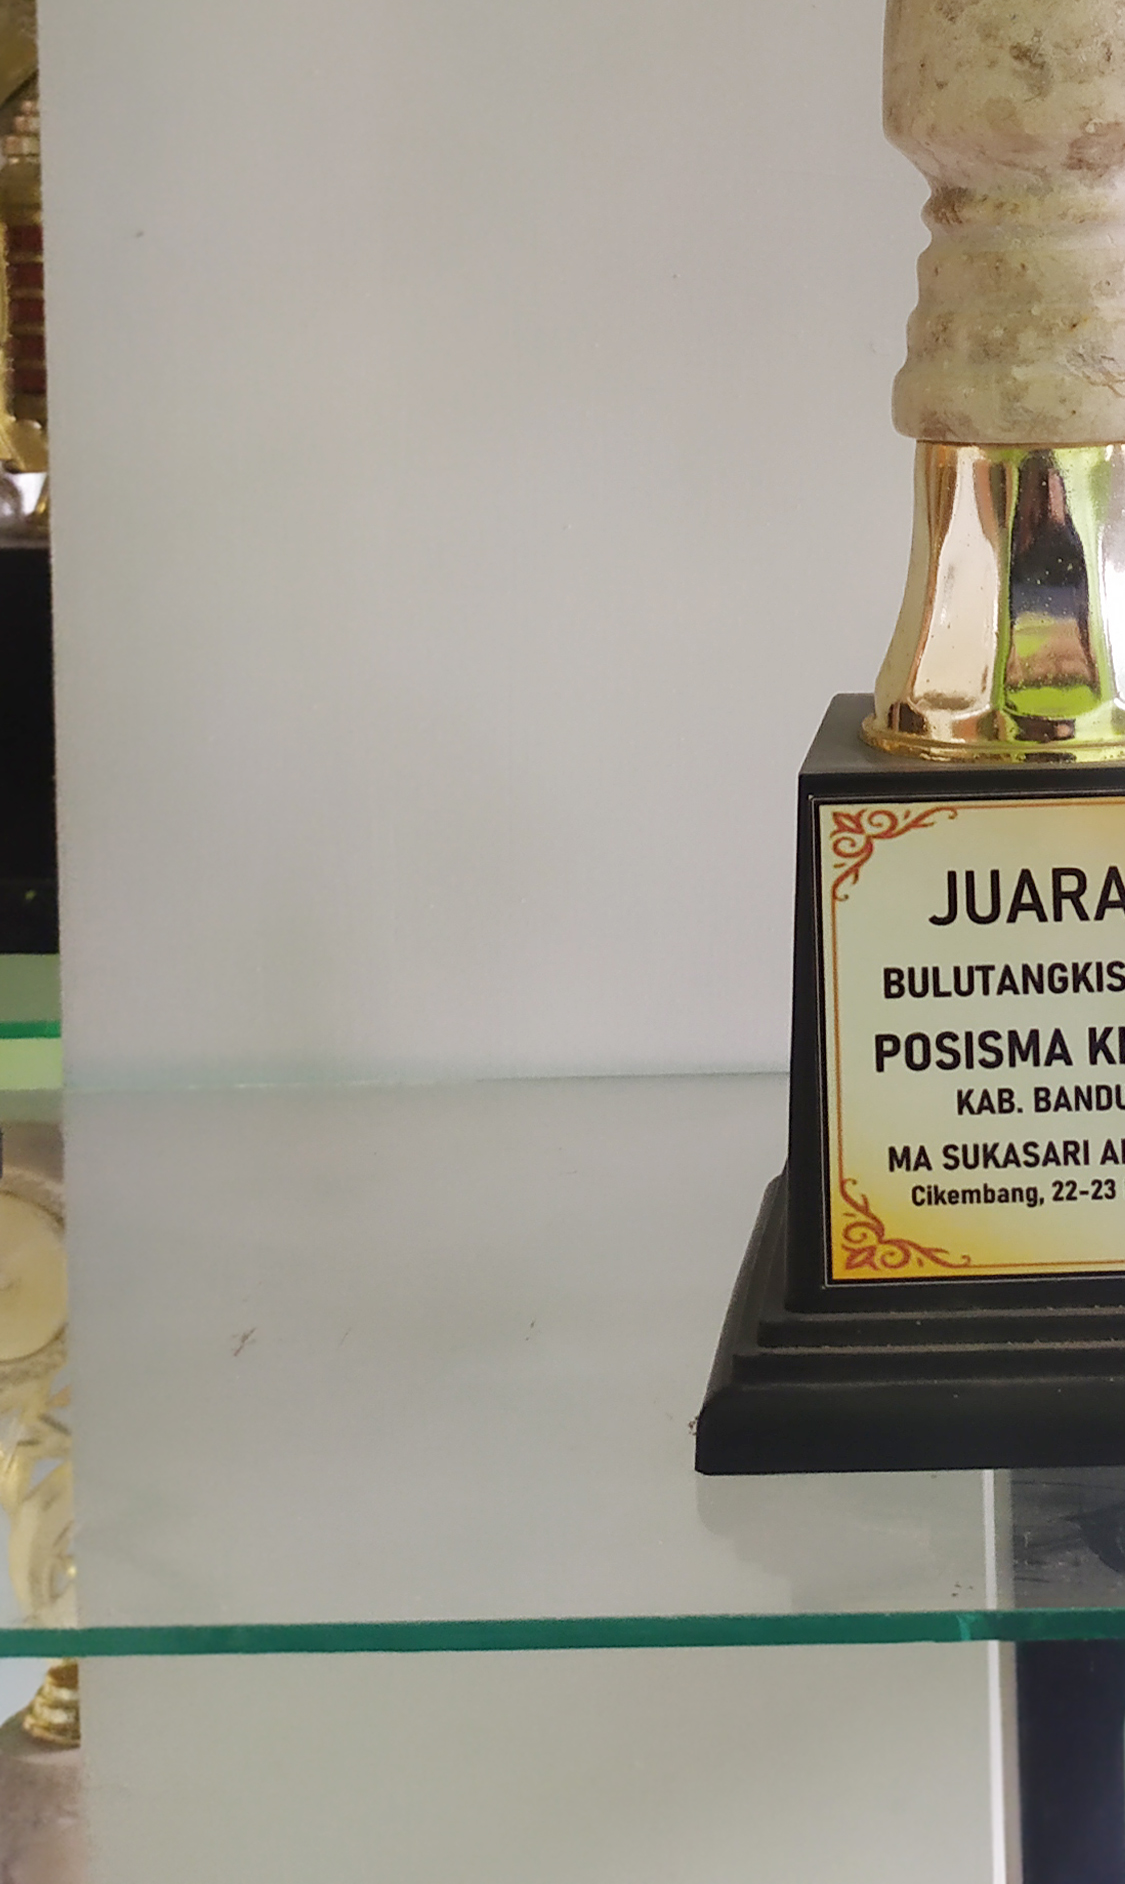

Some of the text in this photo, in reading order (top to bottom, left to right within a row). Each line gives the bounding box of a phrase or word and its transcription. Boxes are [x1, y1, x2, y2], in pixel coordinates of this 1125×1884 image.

[874, 1028, 1074, 1073] POSISMA
[956, 1087, 1024, 1116] KAB.
[887, 1145, 933, 1173] MA
[942, 1139, 1091, 1171] SUKASARI
[911, 1183, 1046, 1208] Cikembang,
[1051, 1180, 1117, 1202] 22-23
